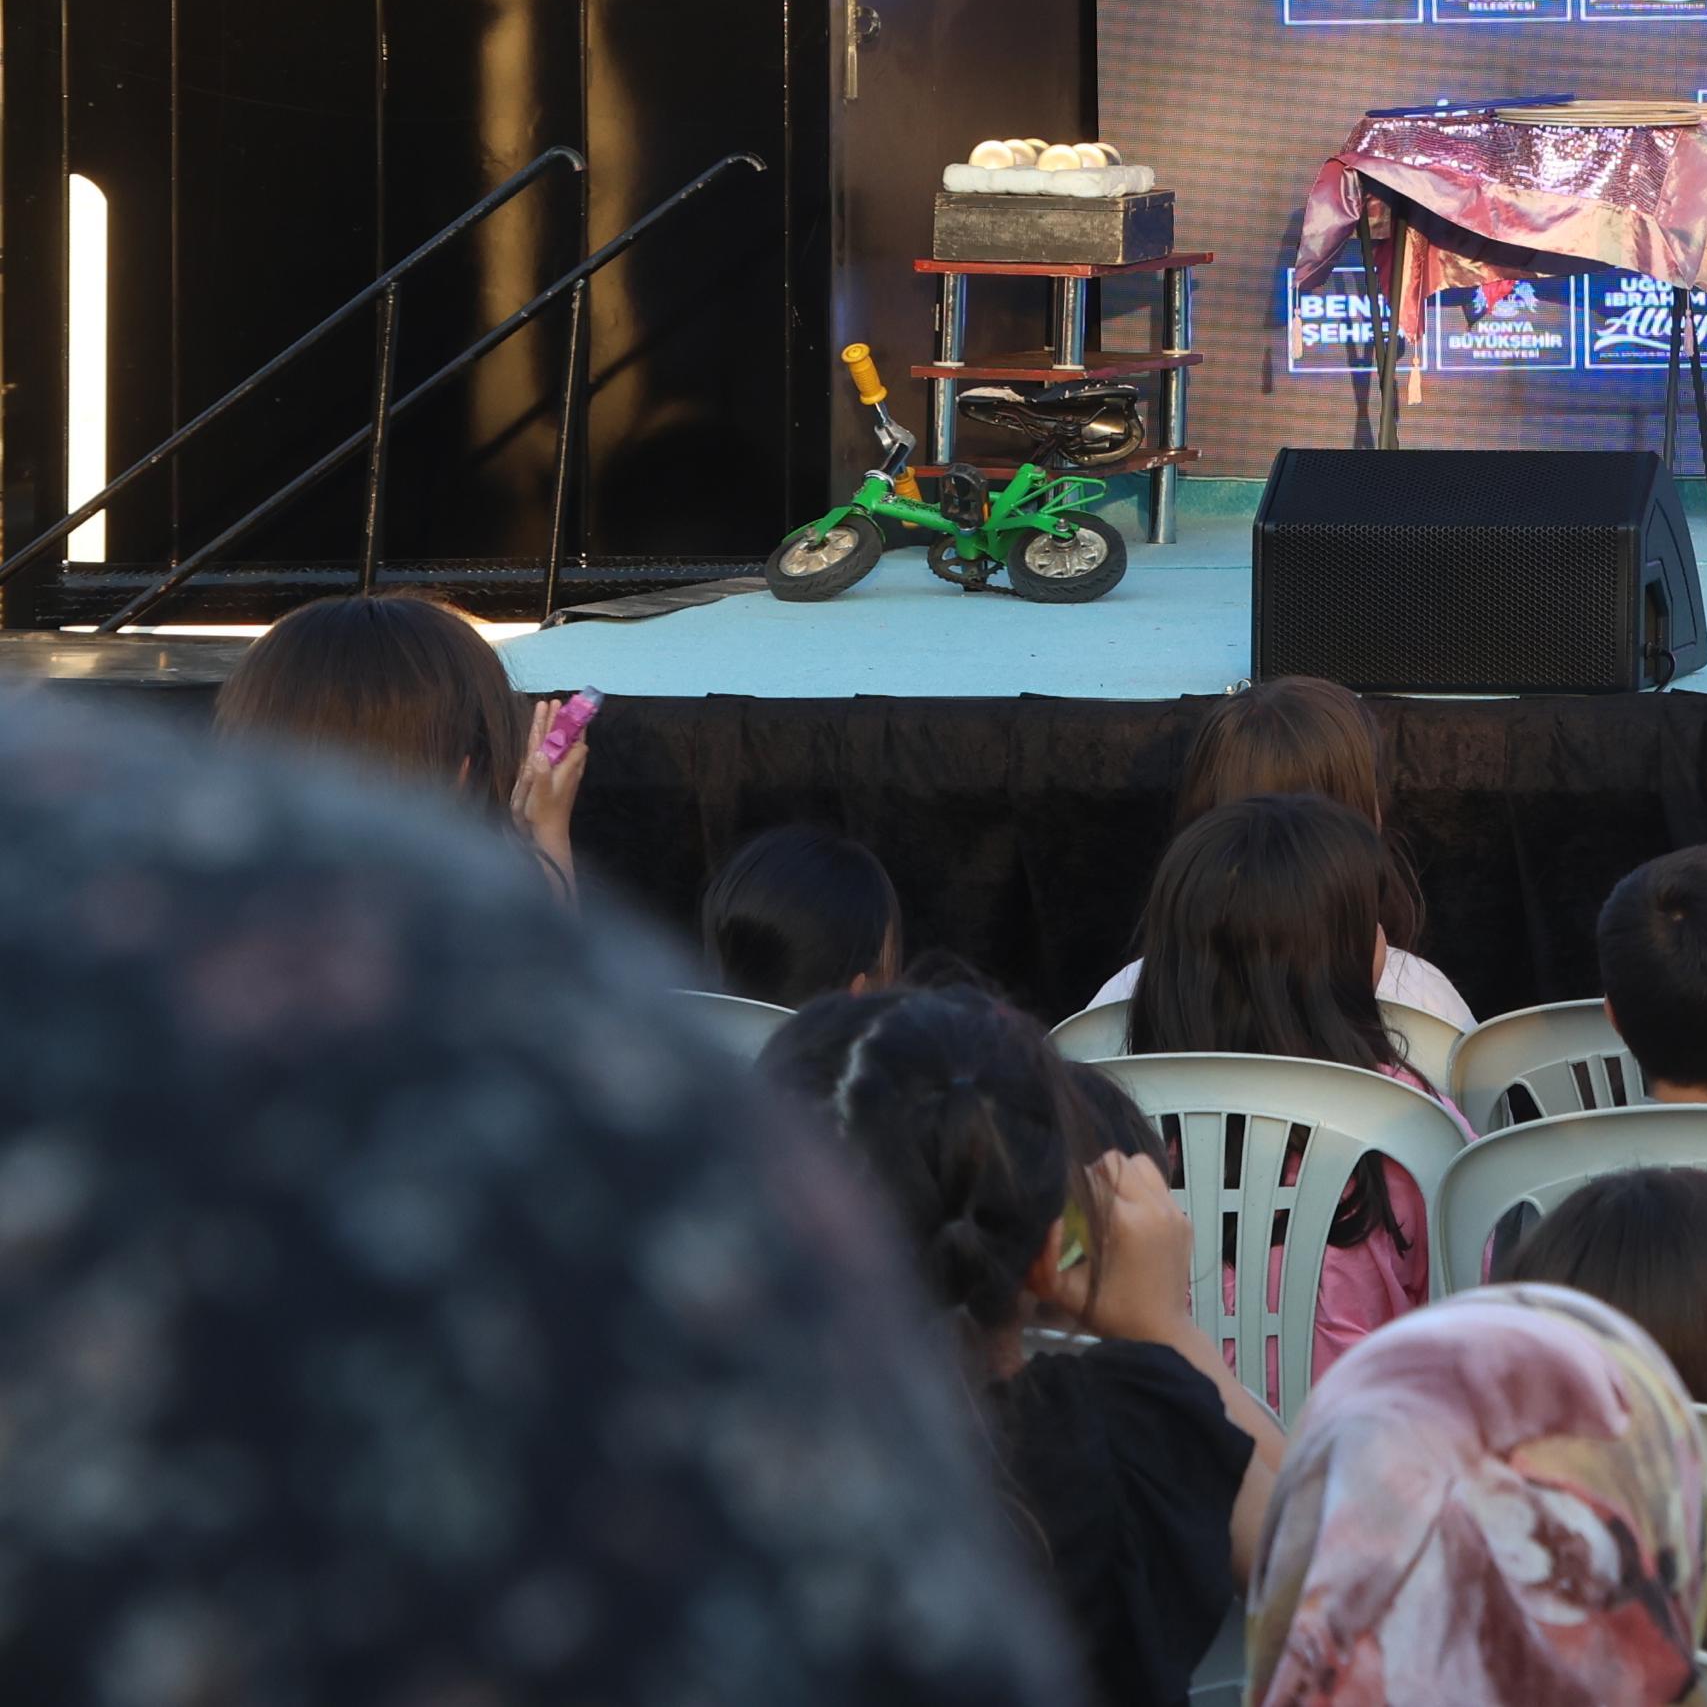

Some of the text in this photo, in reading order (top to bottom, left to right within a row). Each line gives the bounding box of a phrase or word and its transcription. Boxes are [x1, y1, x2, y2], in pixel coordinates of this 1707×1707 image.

[1620, 274, 1674, 292] UĞU
[1604, 292, 1706, 307] İBRAHM
[1478, 322, 1534, 334] KONYA
[1449, 332, 1563, 350] BÜYÜKŞEHİR
